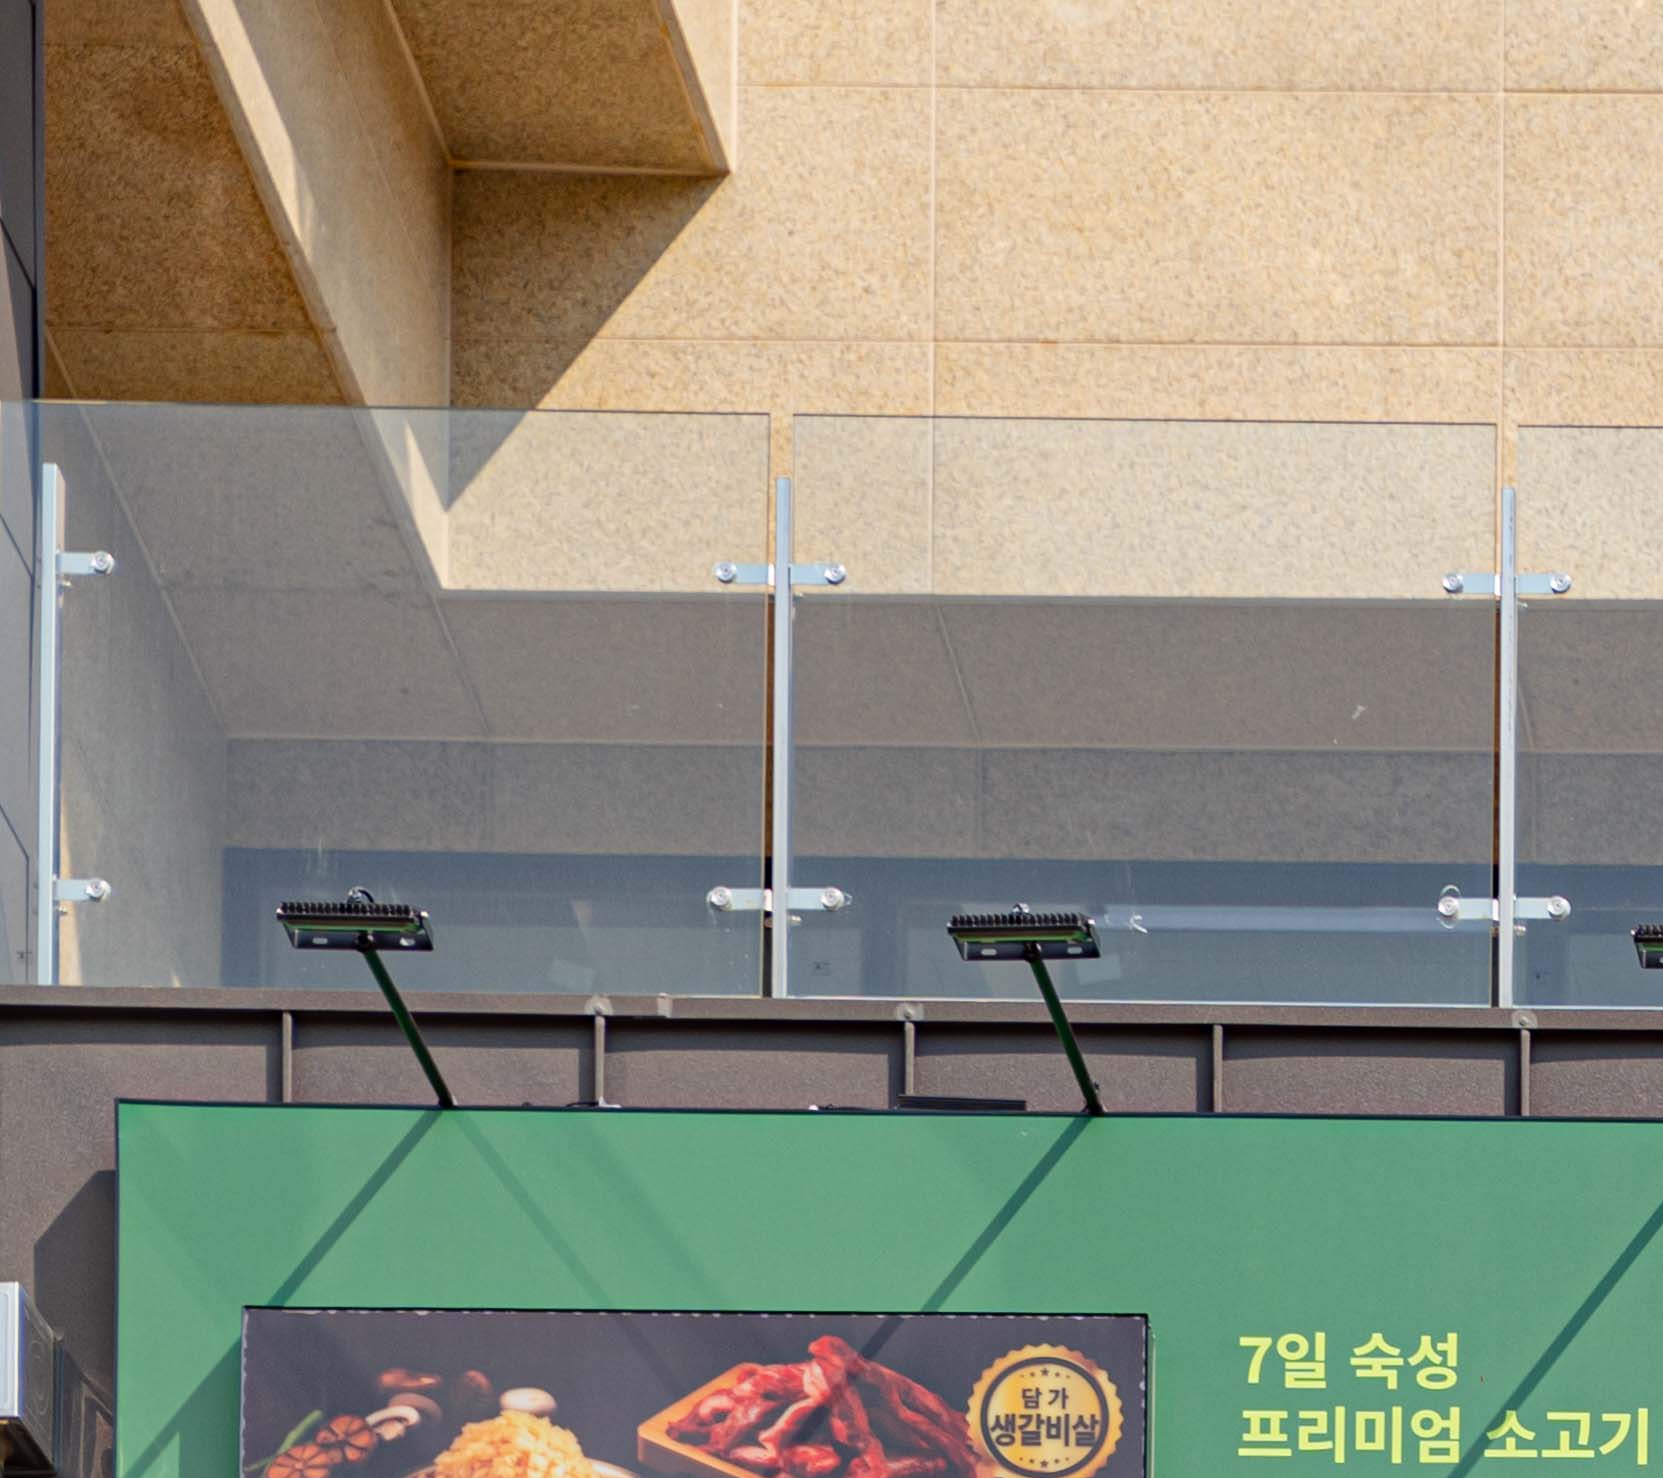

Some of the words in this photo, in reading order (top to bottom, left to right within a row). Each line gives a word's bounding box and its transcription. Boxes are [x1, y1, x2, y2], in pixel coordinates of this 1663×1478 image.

[1238, 1331, 1328, 1390] 7일
[1349, 1332, 1459, 1390] 숙성
[990, 1413, 1100, 1448] 생갈비살
[1237, 1405, 1461, 1465] 프리미엄
[1483, 1408, 1650, 1466] 소고기
